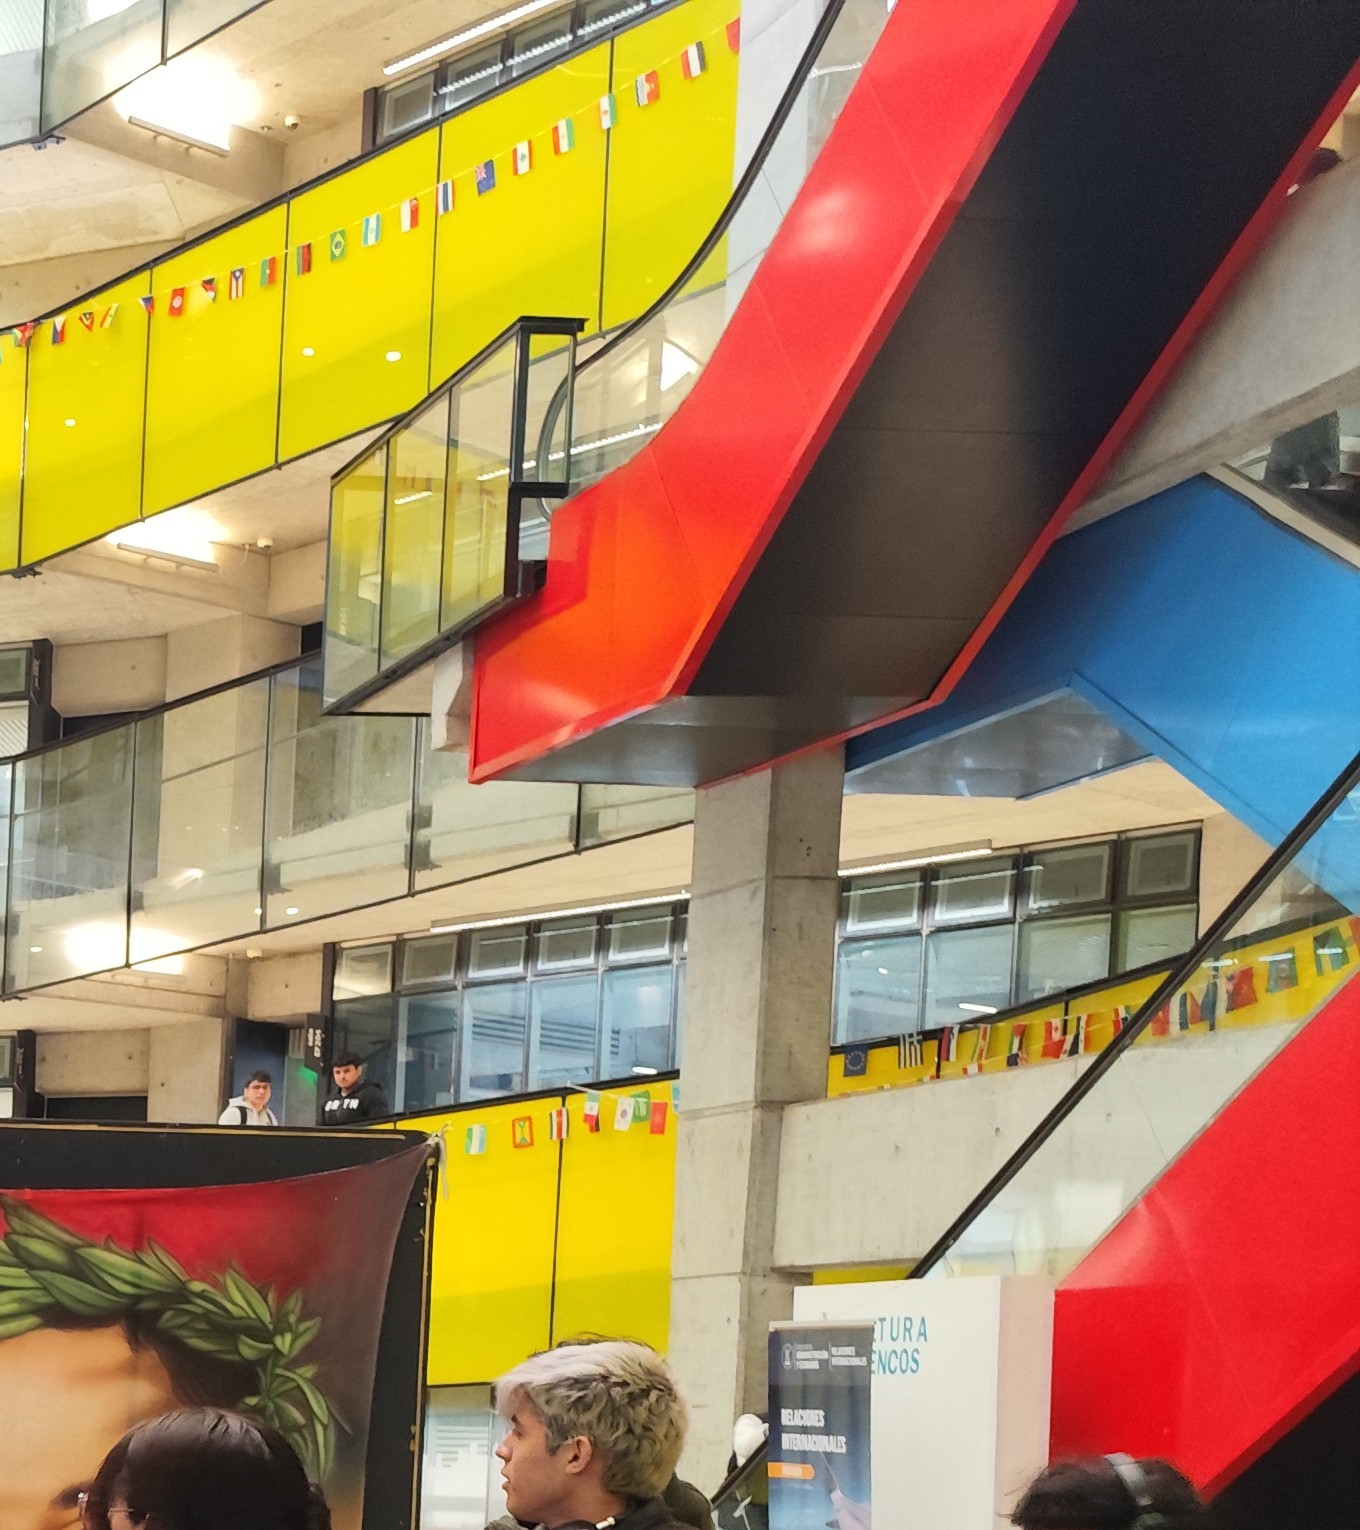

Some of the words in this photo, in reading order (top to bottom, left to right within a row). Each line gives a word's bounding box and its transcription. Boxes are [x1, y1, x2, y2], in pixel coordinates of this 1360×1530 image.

[874, 1316, 928, 1342] TURA
[872, 1348, 921, 1374] NCOS
[781, 1408, 825, 1427] RELACIONES
[781, 1433, 847, 1453] INTERNACIONALES
